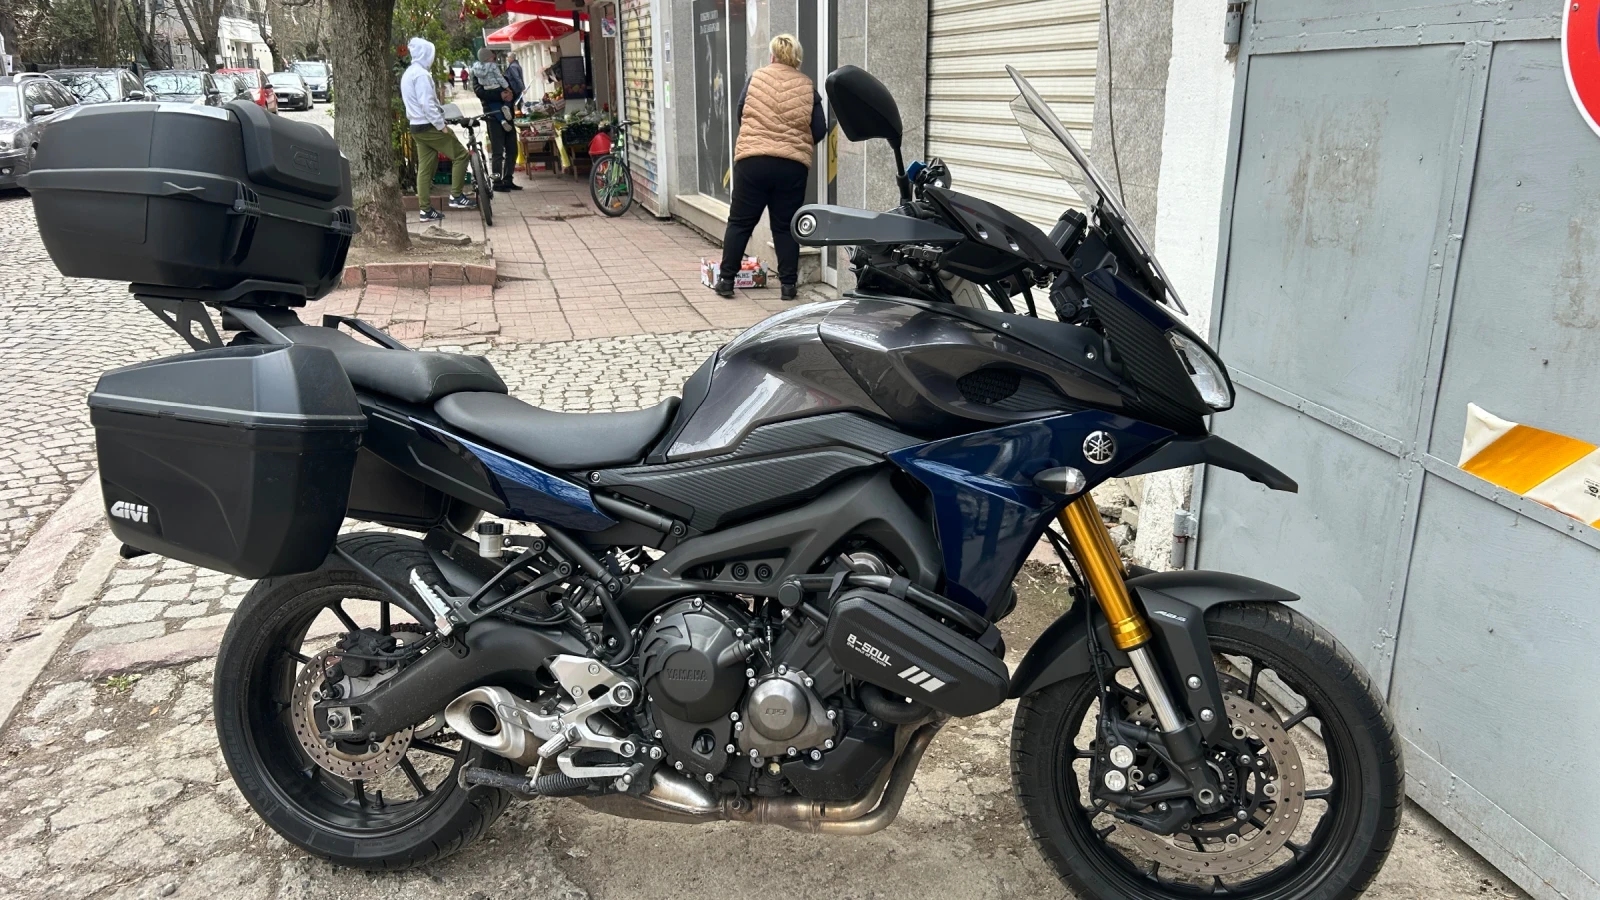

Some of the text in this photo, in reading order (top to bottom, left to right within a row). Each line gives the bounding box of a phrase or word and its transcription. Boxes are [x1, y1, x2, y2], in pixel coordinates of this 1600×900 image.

[110, 500, 149, 523] GIVI
[846, 633, 892, 666] B-SOUL
[666, 668, 708, 682] YAMAHA
